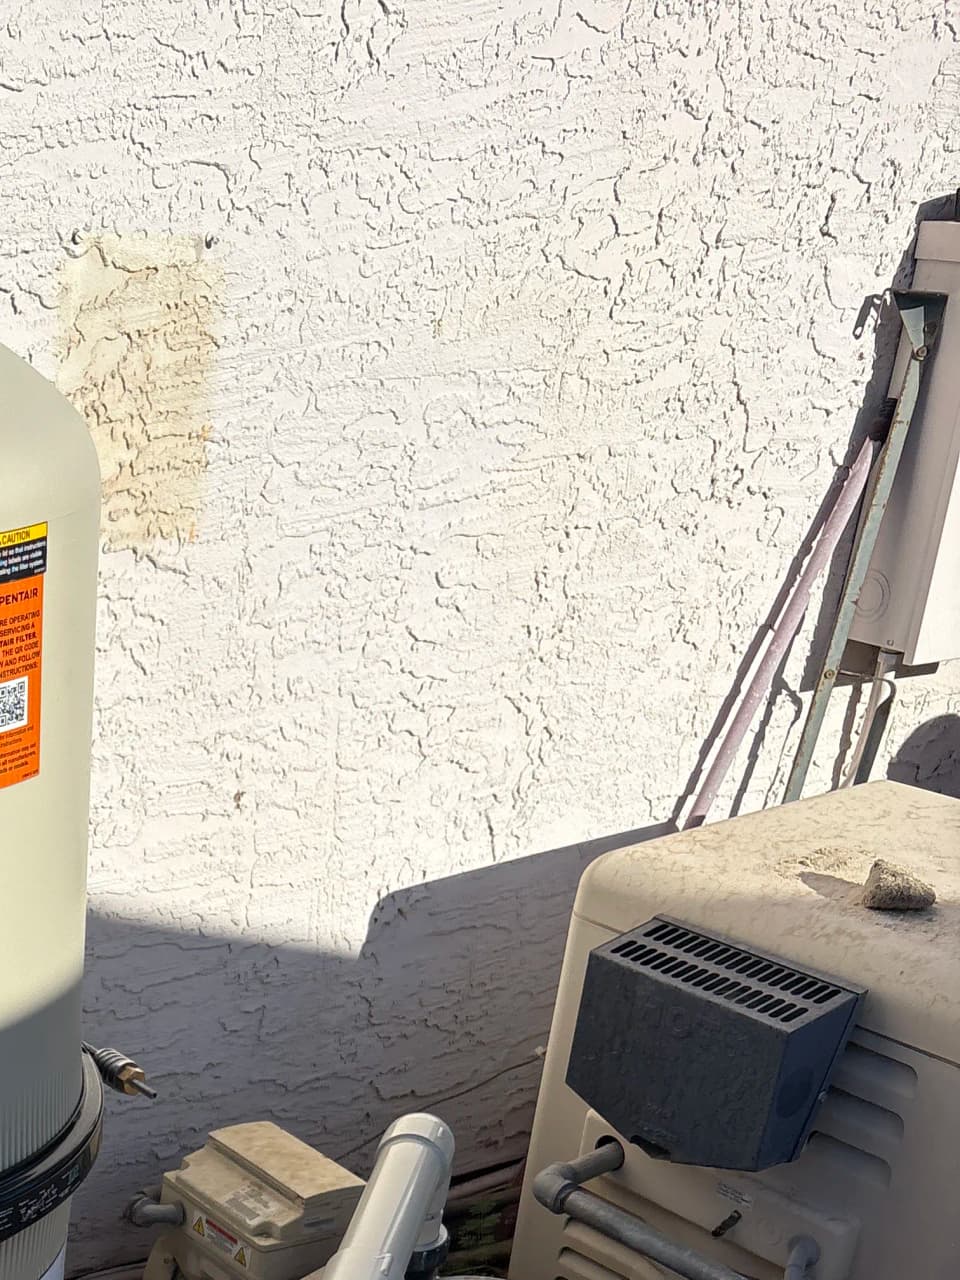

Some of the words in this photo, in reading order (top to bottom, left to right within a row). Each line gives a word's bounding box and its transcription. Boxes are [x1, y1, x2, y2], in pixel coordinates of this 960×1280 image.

[2, 530, 30, 545] CAUTION
[9, 609, 40, 625] OPERATING
[0, 623, 30, 638] SERVICING
[2, 648, 13, 657] THE
[15, 646, 23, 654] QR
[24, 640, 39, 651] CODE
[5, 658, 17, 667] AND
[18, 650, 40, 662] FOLLOW
